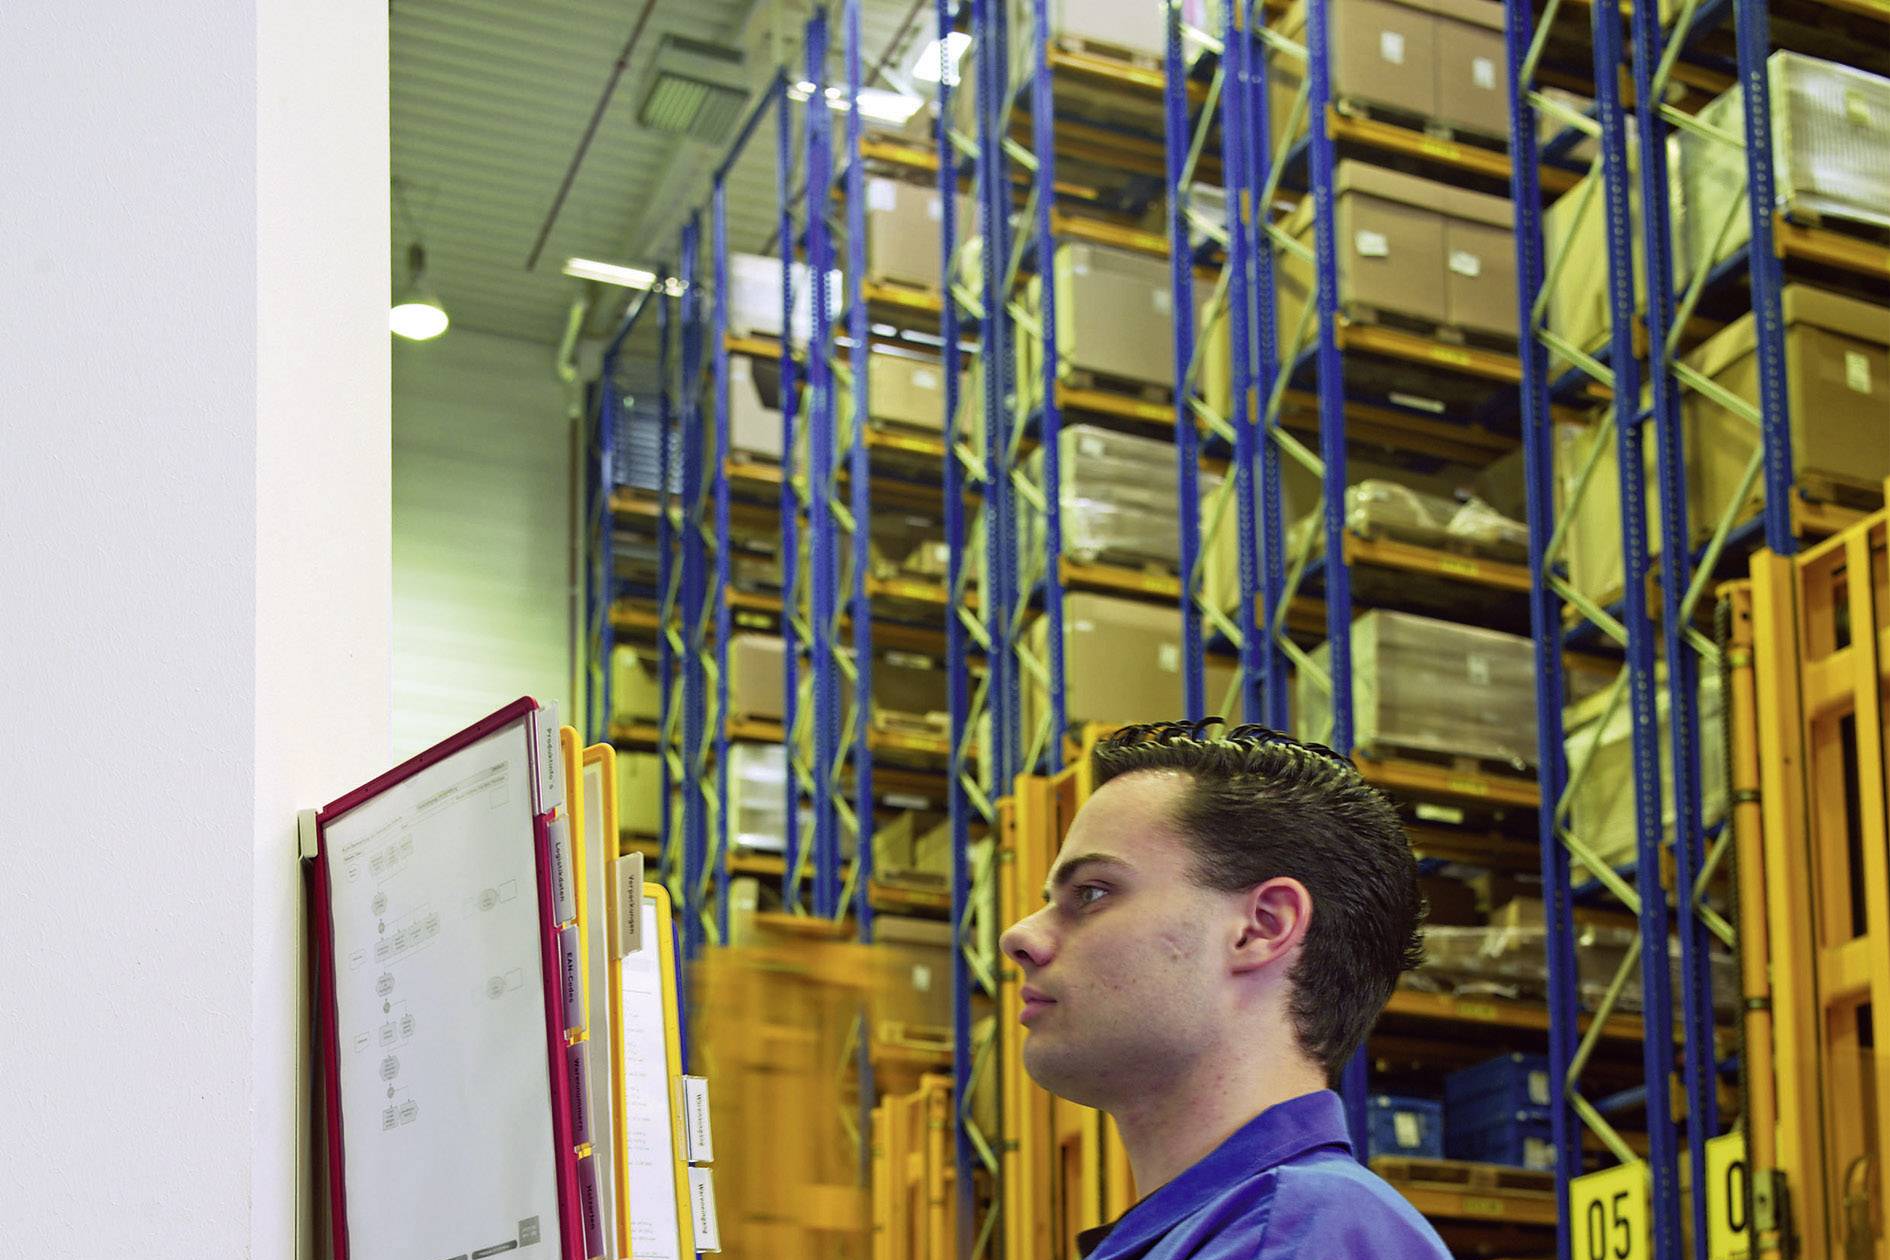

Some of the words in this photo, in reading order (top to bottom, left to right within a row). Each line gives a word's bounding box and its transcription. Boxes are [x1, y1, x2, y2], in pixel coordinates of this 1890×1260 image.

[555, 842, 565, 902] Logistikdaten
[627, 874, 635, 935] Verpackungen
[566, 952, 575, 1003] EAN-Codes
[1727, 1160, 1748, 1233] 0
